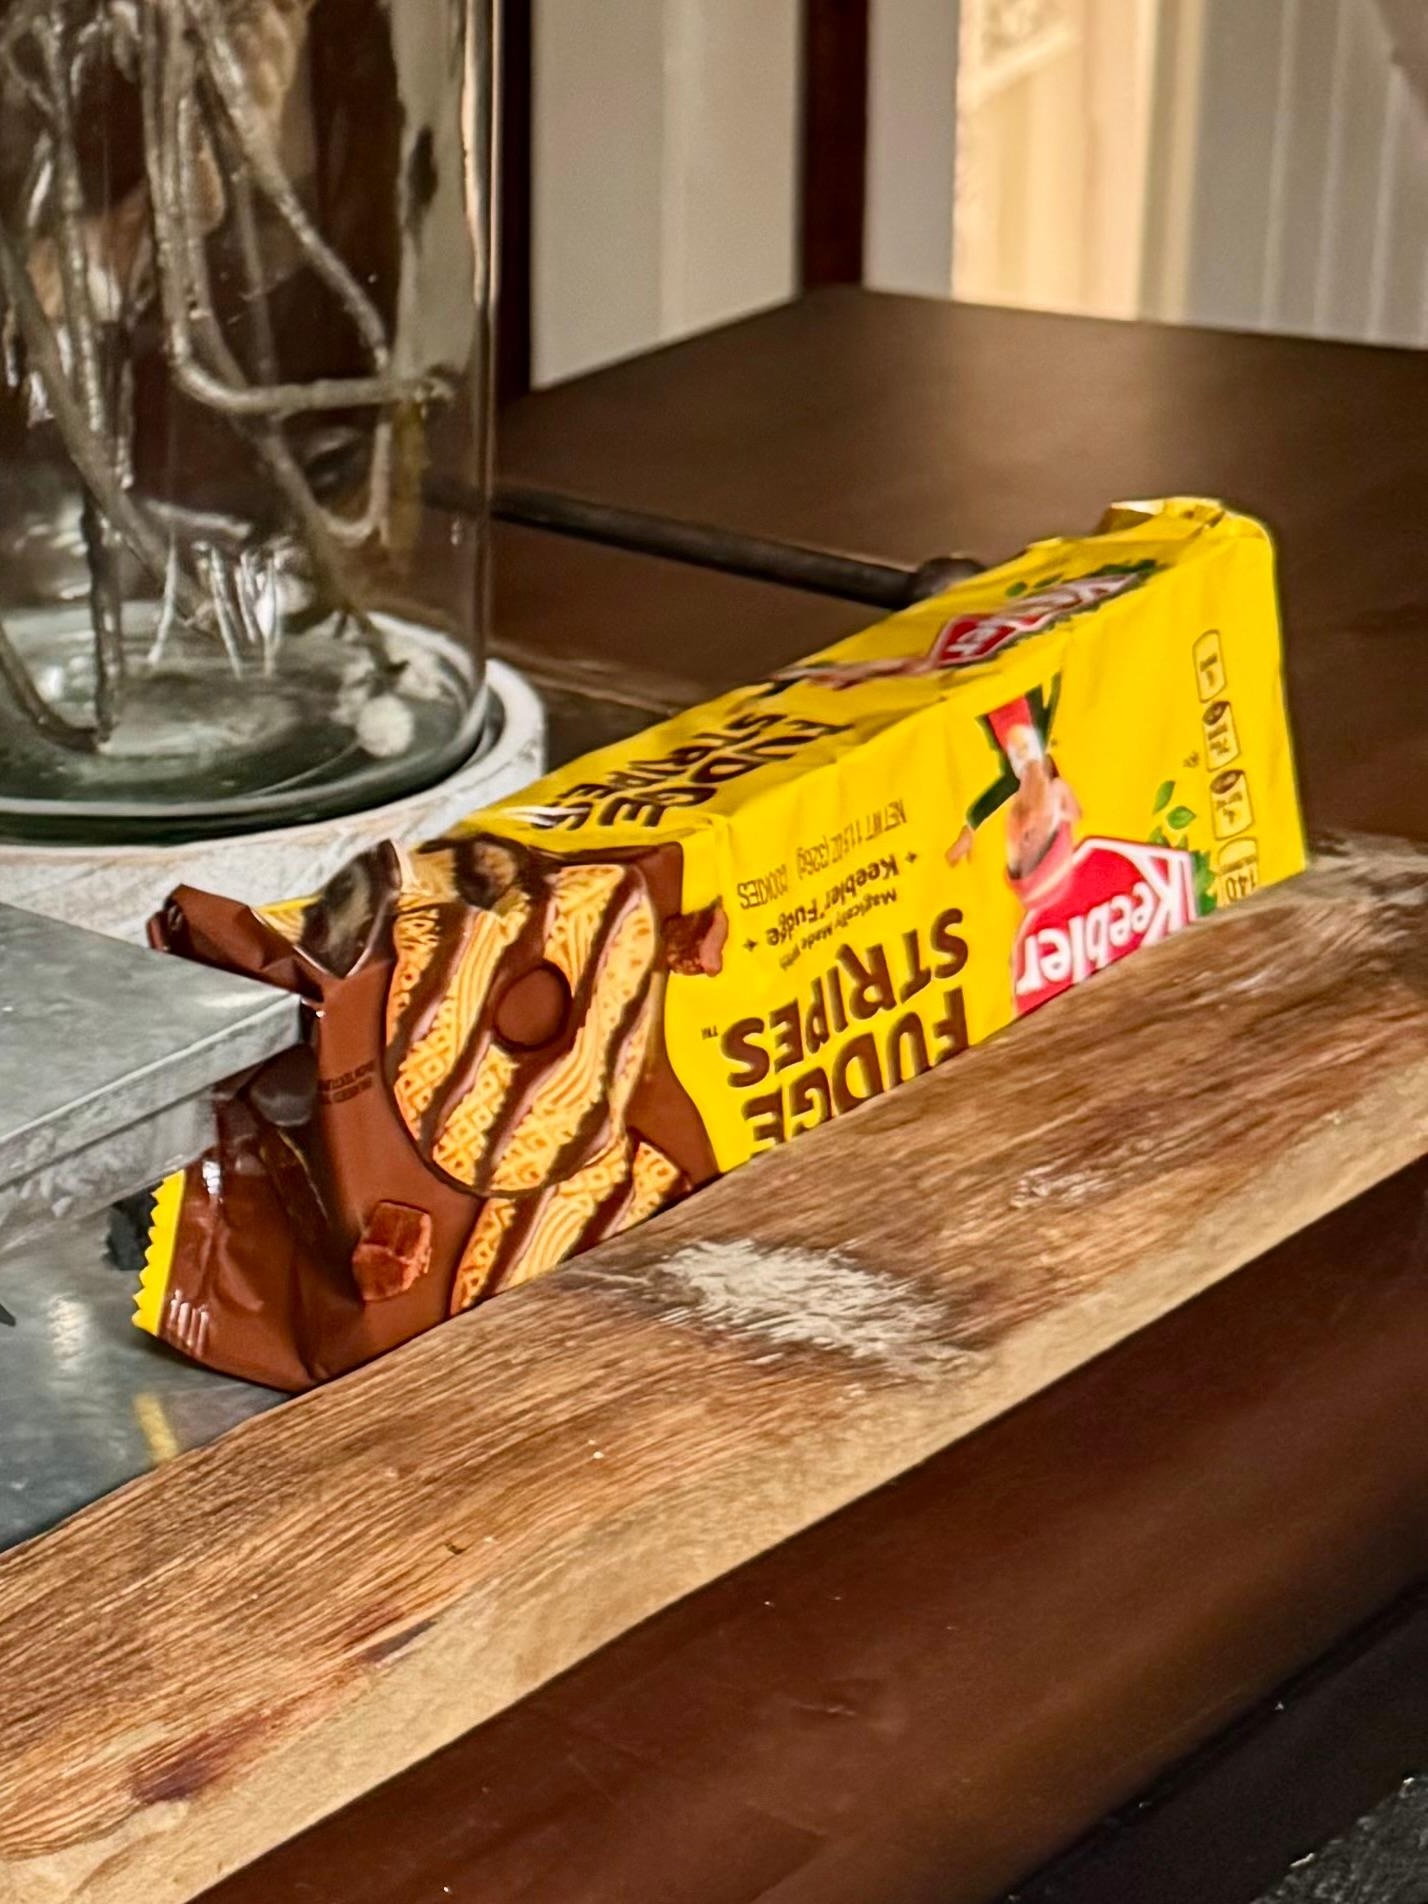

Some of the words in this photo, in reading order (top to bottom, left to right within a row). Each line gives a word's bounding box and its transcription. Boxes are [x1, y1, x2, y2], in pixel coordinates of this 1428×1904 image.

[531, 713, 788, 830] STRIPES
[597, 718, 854, 828] FUDGE
[765, 898, 818, 947] Fudge
[801, 921, 833, 949] Made
[824, 853, 899, 911] Keebler
[835, 888, 897, 928] Magically
[1015, 854, 1188, 996] Keebler
[720, 907, 969, 1088] STRIPES
[741, 985, 970, 1158] FUDGE
